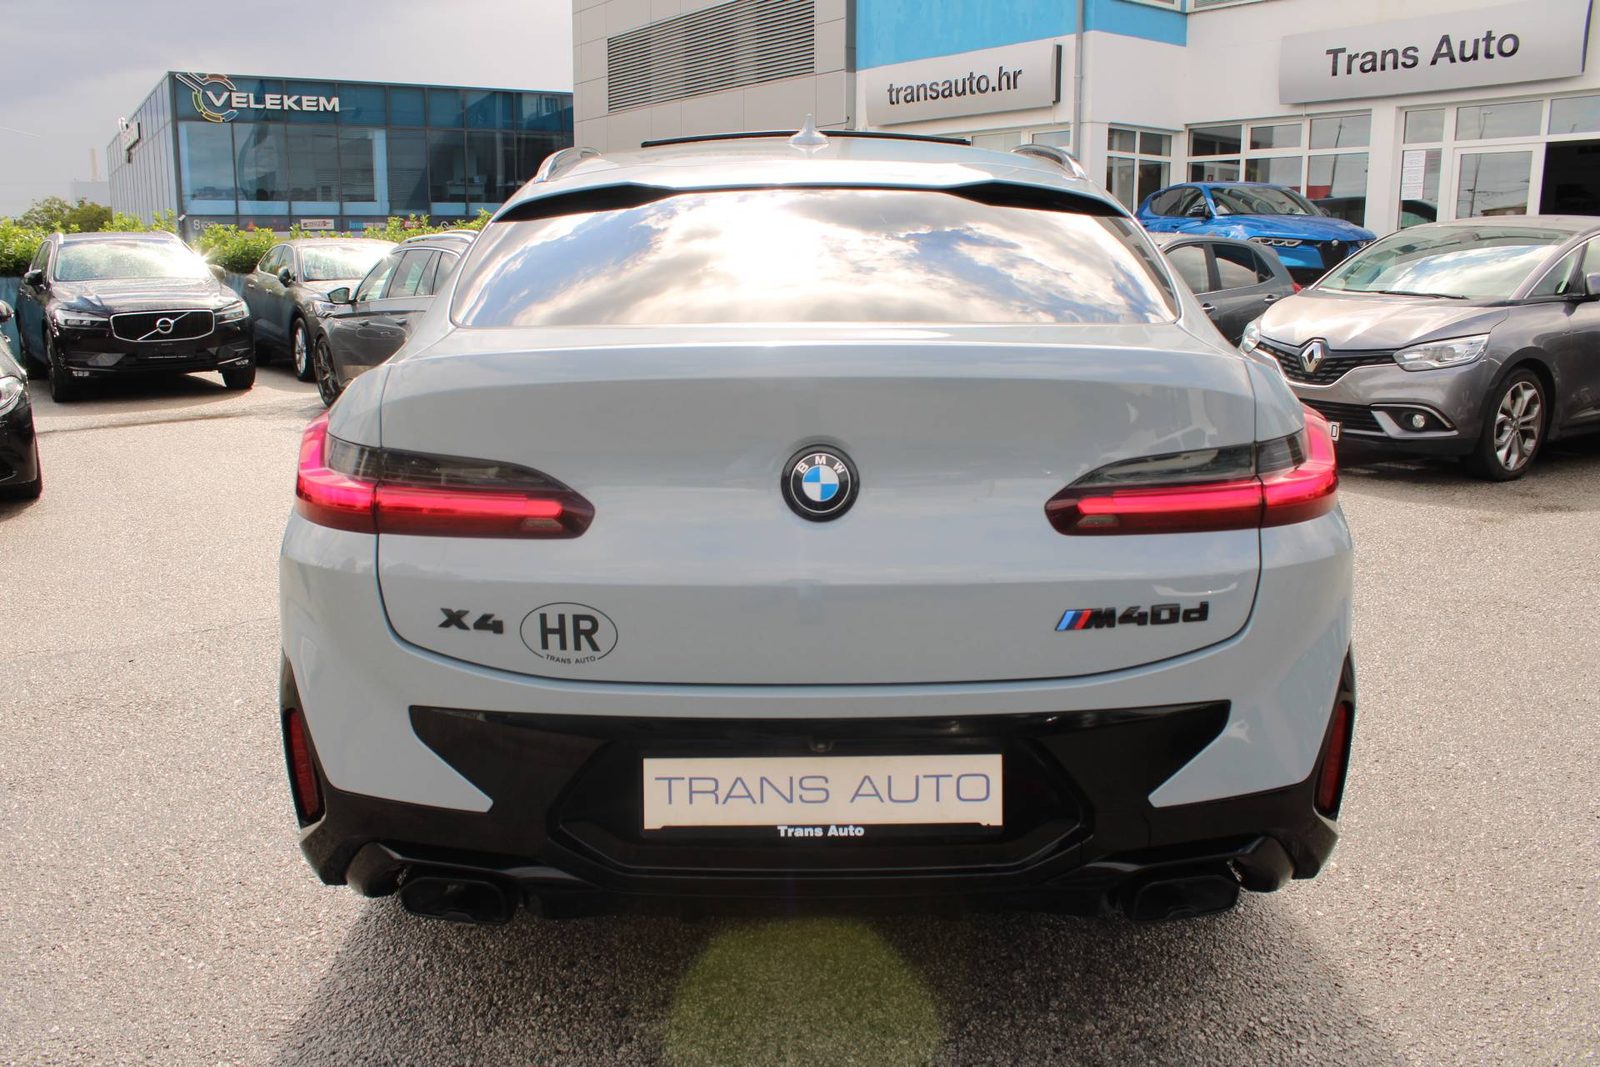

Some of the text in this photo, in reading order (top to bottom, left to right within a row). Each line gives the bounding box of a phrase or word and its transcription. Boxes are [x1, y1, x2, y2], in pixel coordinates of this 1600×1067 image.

[1326, 30, 1520, 77] Trans Auto
[887, 66, 1022, 106] transauto.hr
[206, 90, 340, 112] VELEKEM
[796, 455, 845, 474] BMW
[438, 607, 504, 634] X4
[1089, 601, 1209, 629] M40d
[539, 613, 601, 652] HR
[545, 654, 596, 665] TRANS AUTO
[655, 773, 991, 805] TRANS AUTO
[777, 824, 865, 838] Trans Auto
